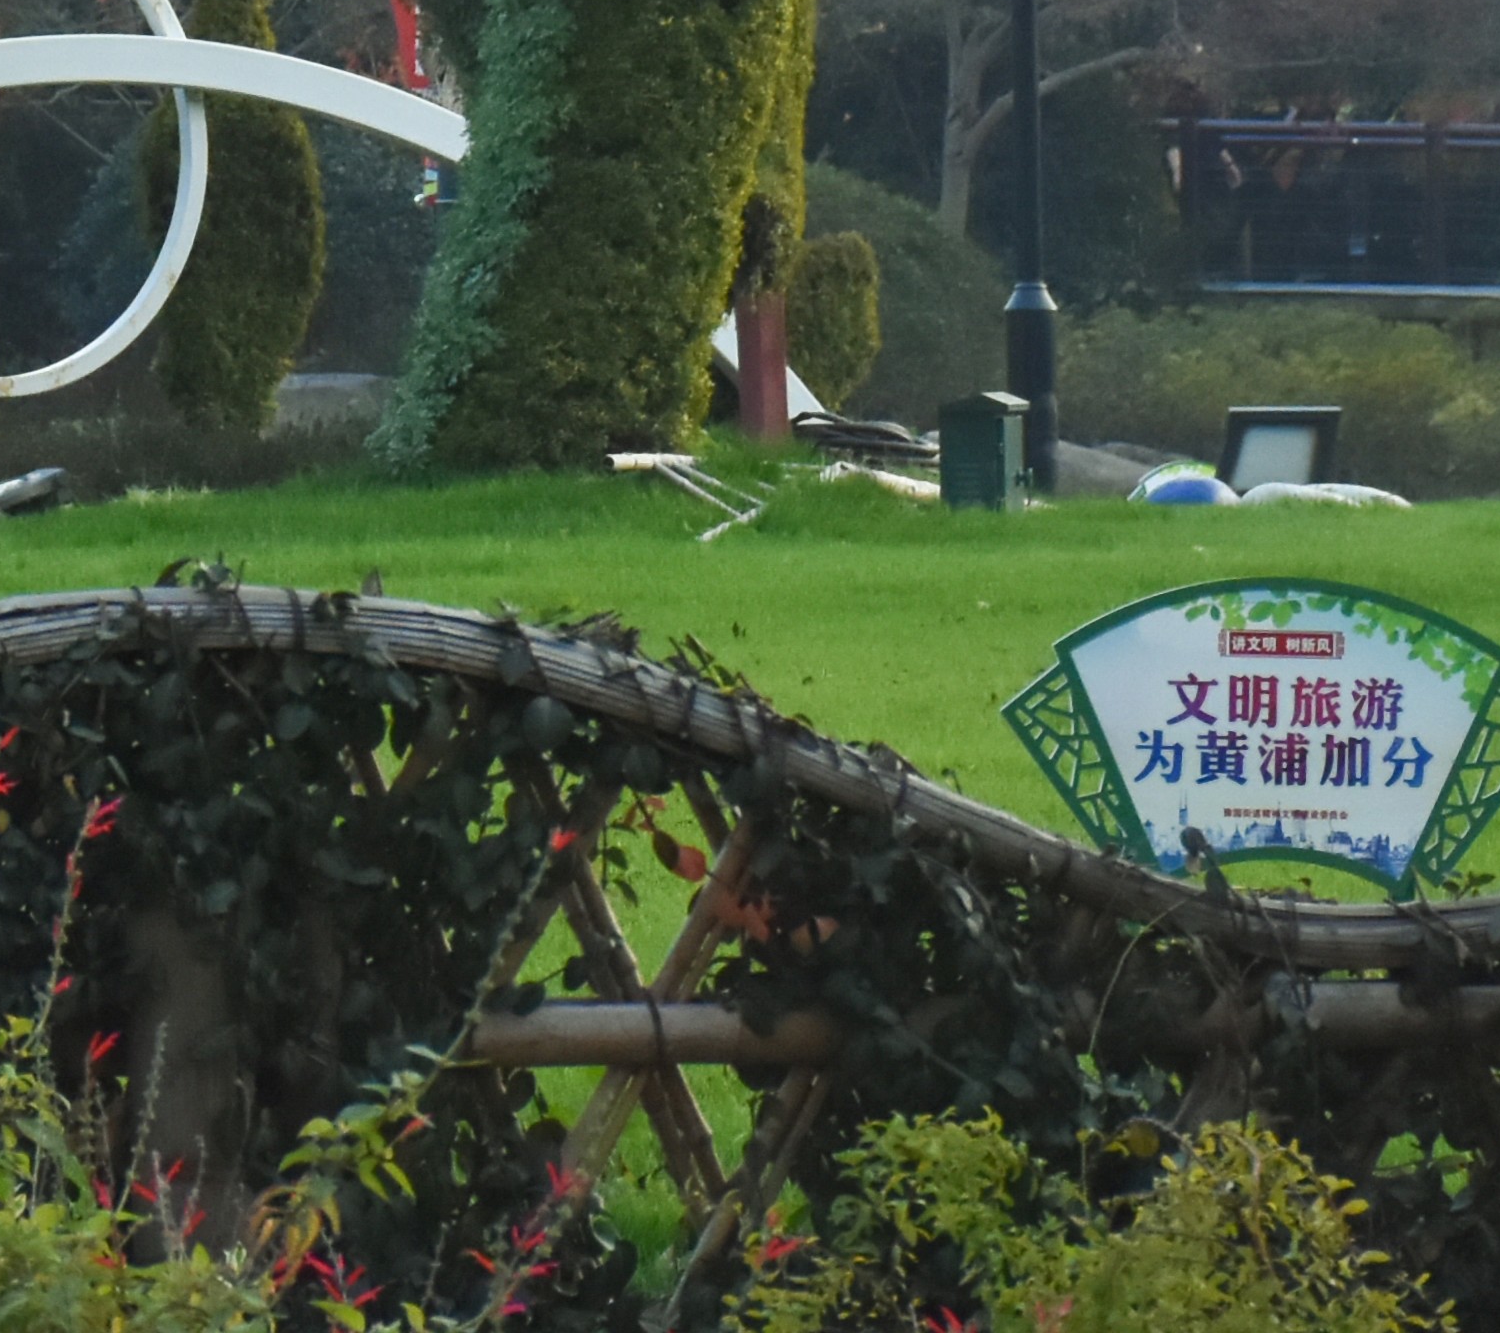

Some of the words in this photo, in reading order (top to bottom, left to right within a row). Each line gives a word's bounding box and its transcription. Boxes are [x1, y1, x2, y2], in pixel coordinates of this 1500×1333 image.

[1232, 635, 1277, 652] 讲文明
[1286, 637, 1332, 653] 树新风
[1166, 672, 1405, 731] 文明旅游
[1133, 729, 1434, 788] 为黄浦加分
